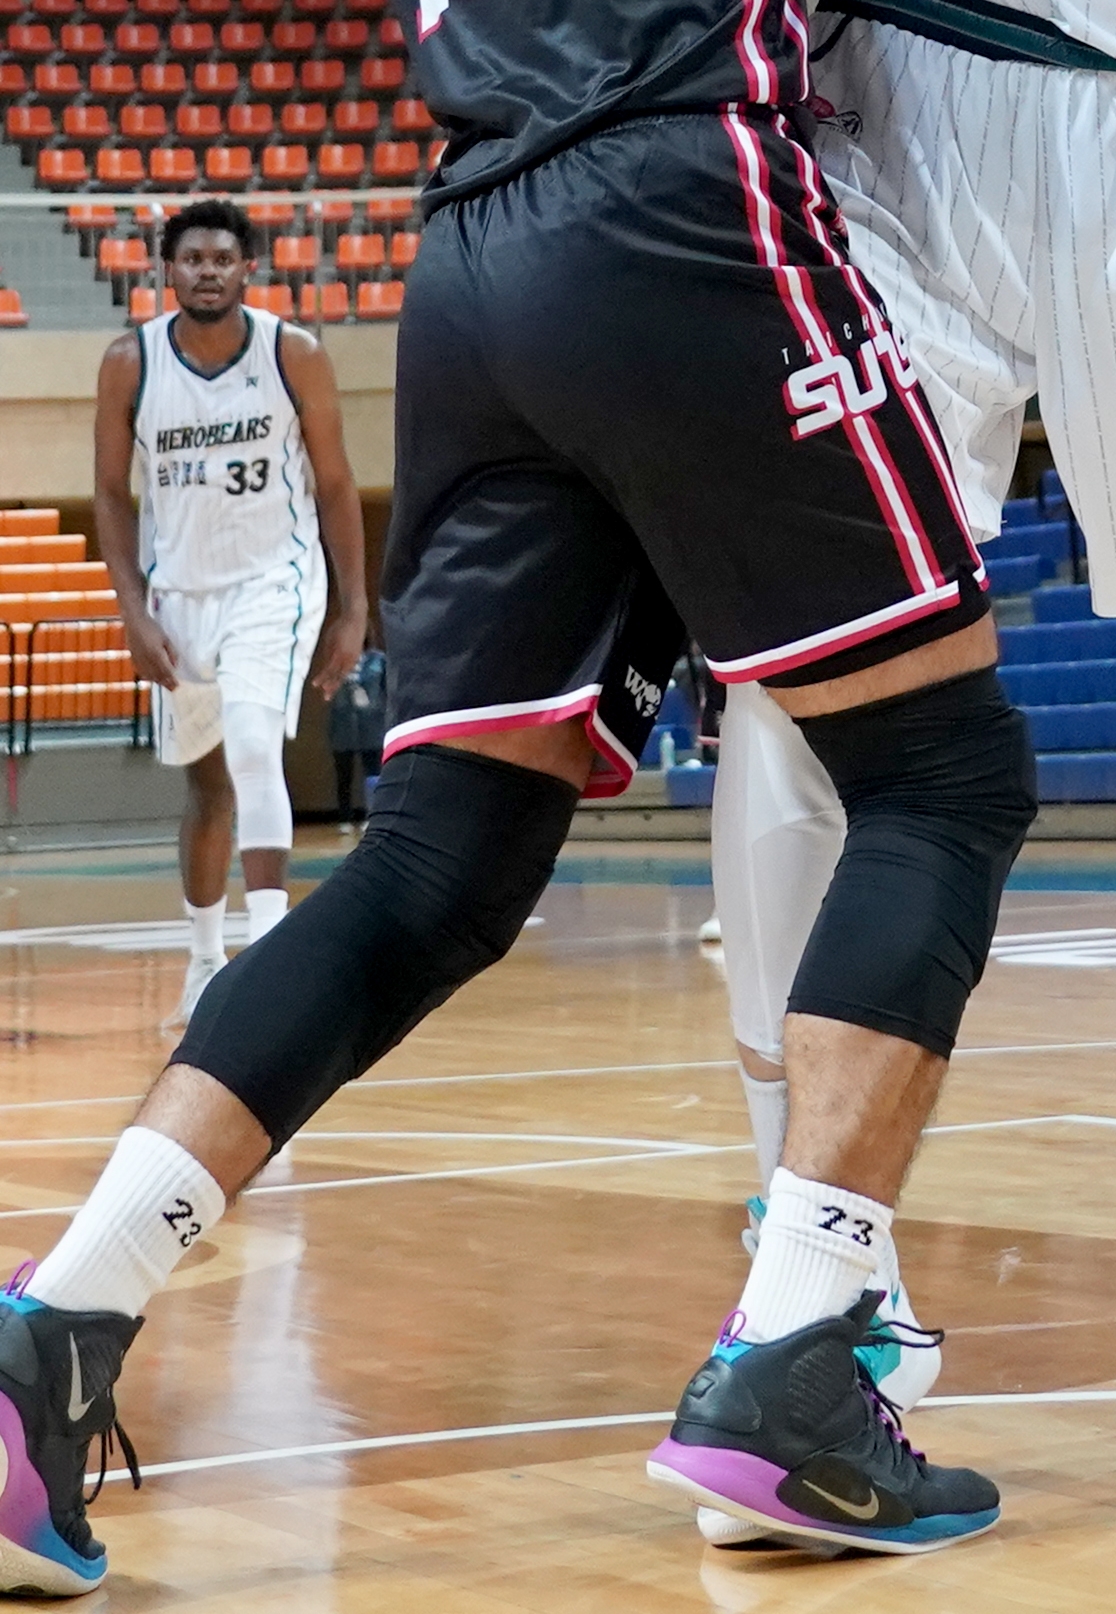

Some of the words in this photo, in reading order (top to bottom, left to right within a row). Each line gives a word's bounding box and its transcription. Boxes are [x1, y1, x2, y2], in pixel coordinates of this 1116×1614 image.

[156, 414, 272, 454] HEROBEARS
[224, 457, 270, 496] 33
[162, 1198, 202, 1248] 23
[818, 1205, 874, 1247] 23
